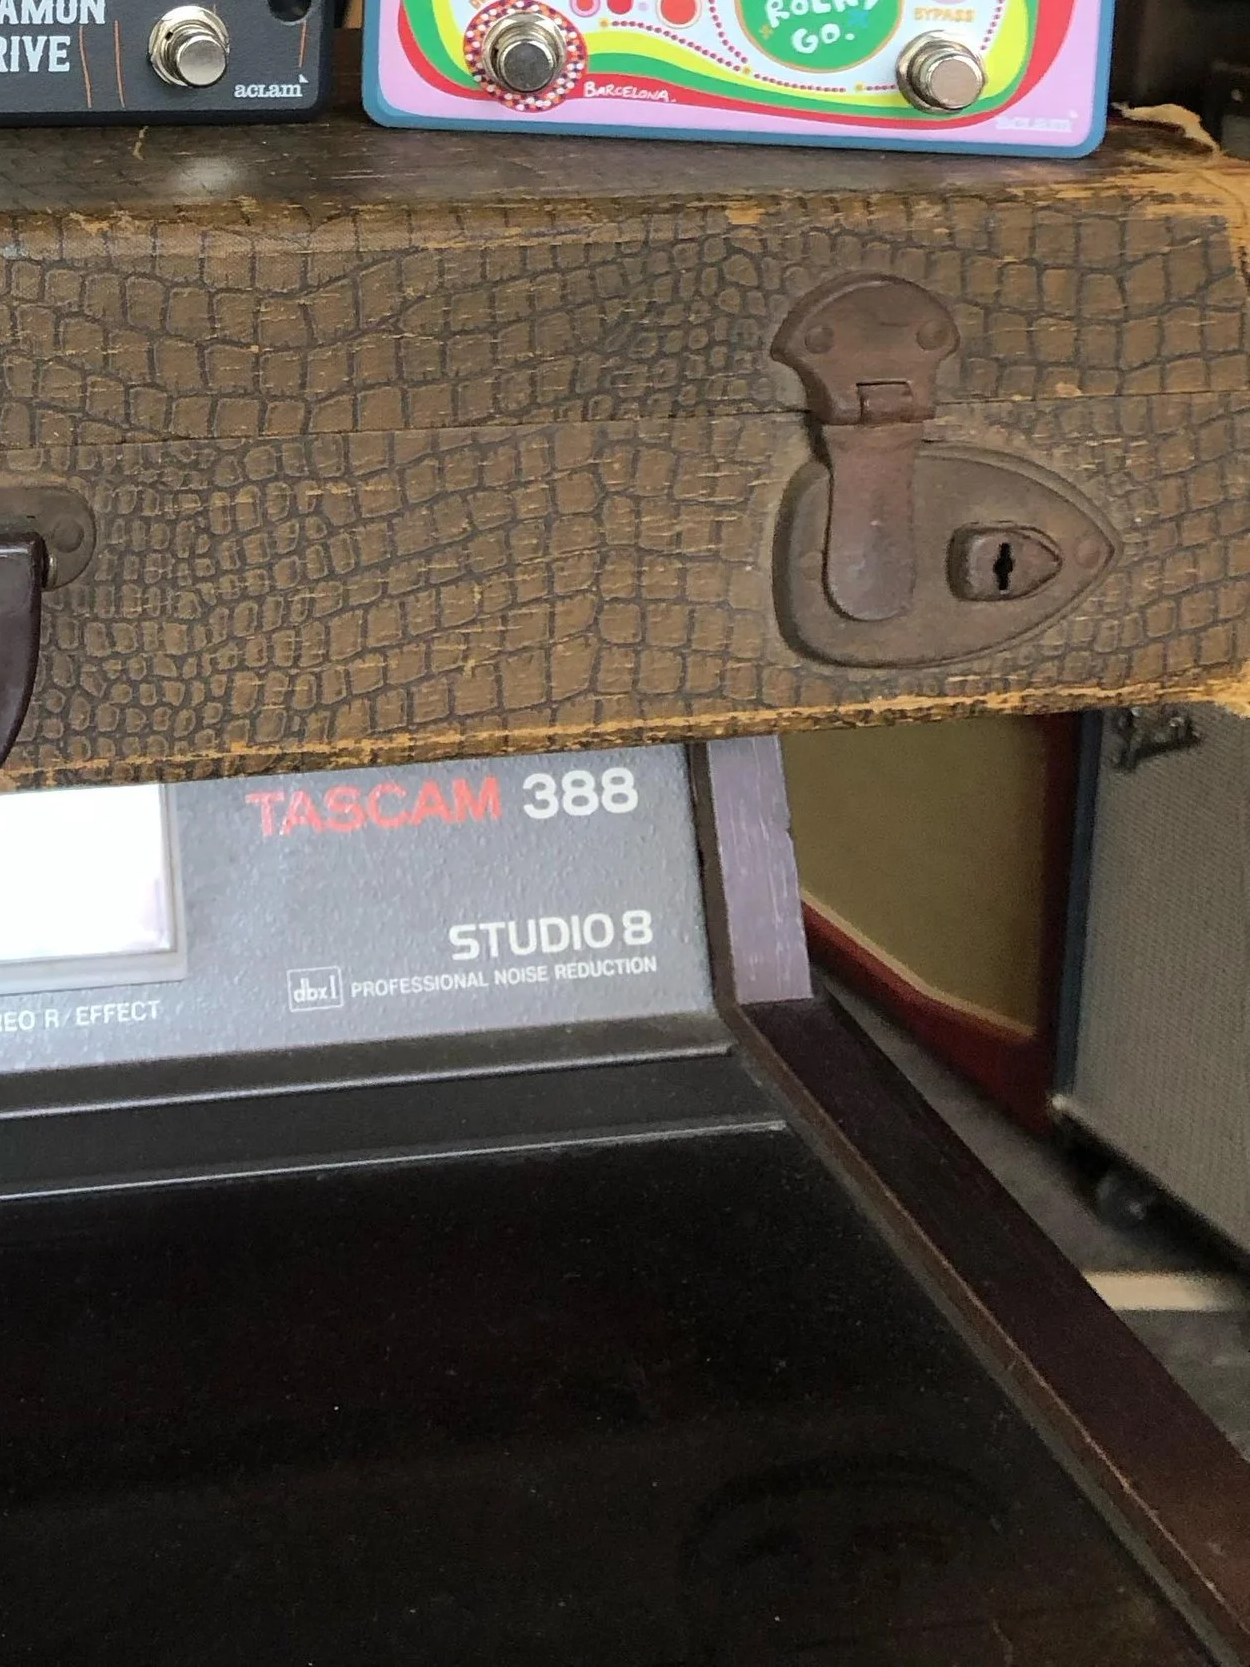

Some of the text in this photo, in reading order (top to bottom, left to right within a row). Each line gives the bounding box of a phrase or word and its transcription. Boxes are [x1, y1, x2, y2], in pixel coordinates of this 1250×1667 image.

[913, 7, 976, 22] BYPASS
[791, 23, 855, 54] GO.
[245, 767, 639, 836] TASCAM 388
[449, 910, 654, 961] STUDIO 8
[350, 956, 658, 998] PROFESSIONAL NOISE REDUCTION
